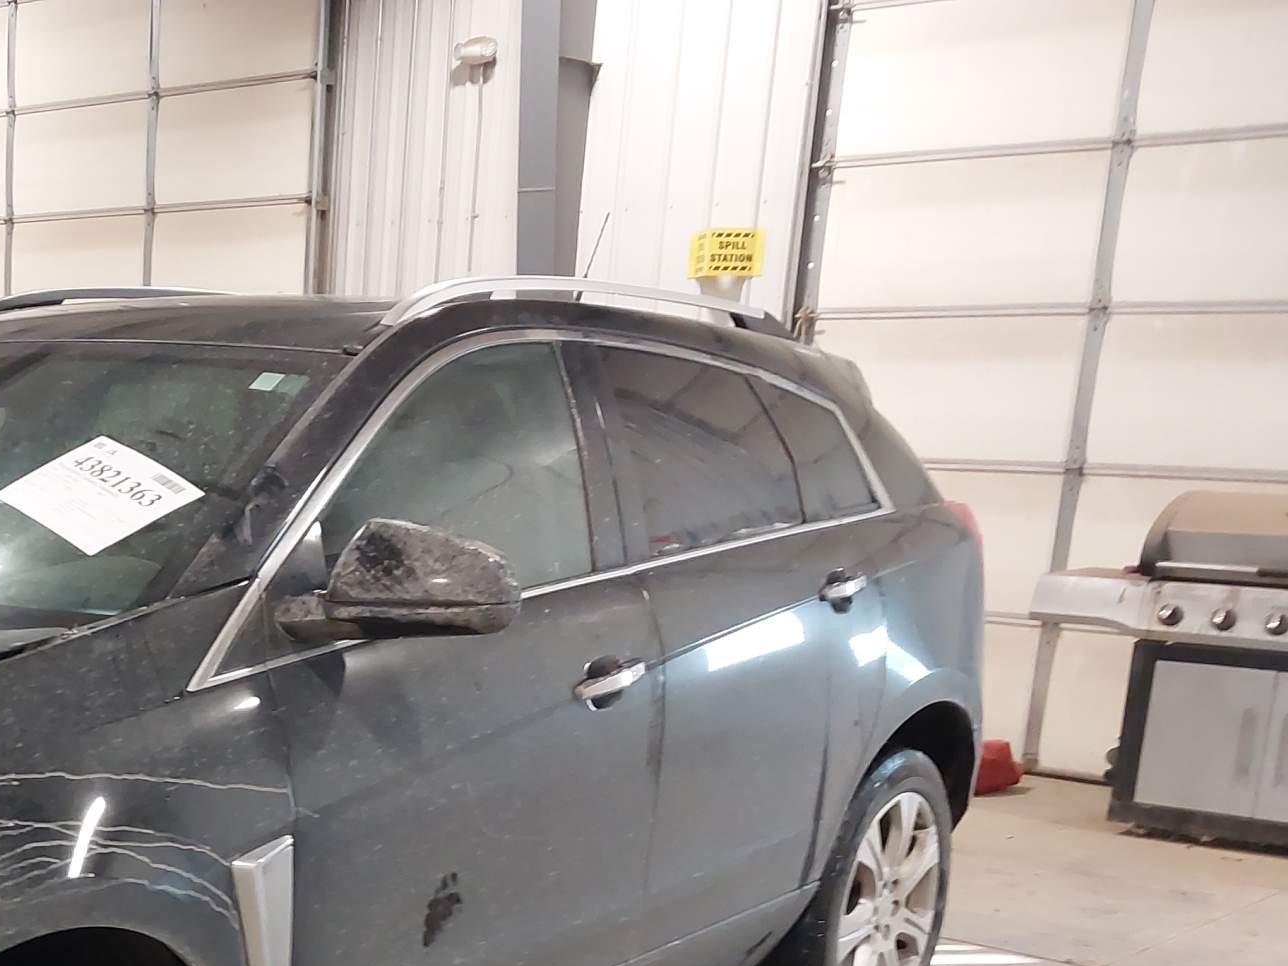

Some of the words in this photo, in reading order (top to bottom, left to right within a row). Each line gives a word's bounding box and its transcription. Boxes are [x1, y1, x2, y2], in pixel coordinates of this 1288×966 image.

[718, 240, 747, 250] SPILL
[710, 253, 753, 262] STATION
[73, 455, 163, 508] 43821363
